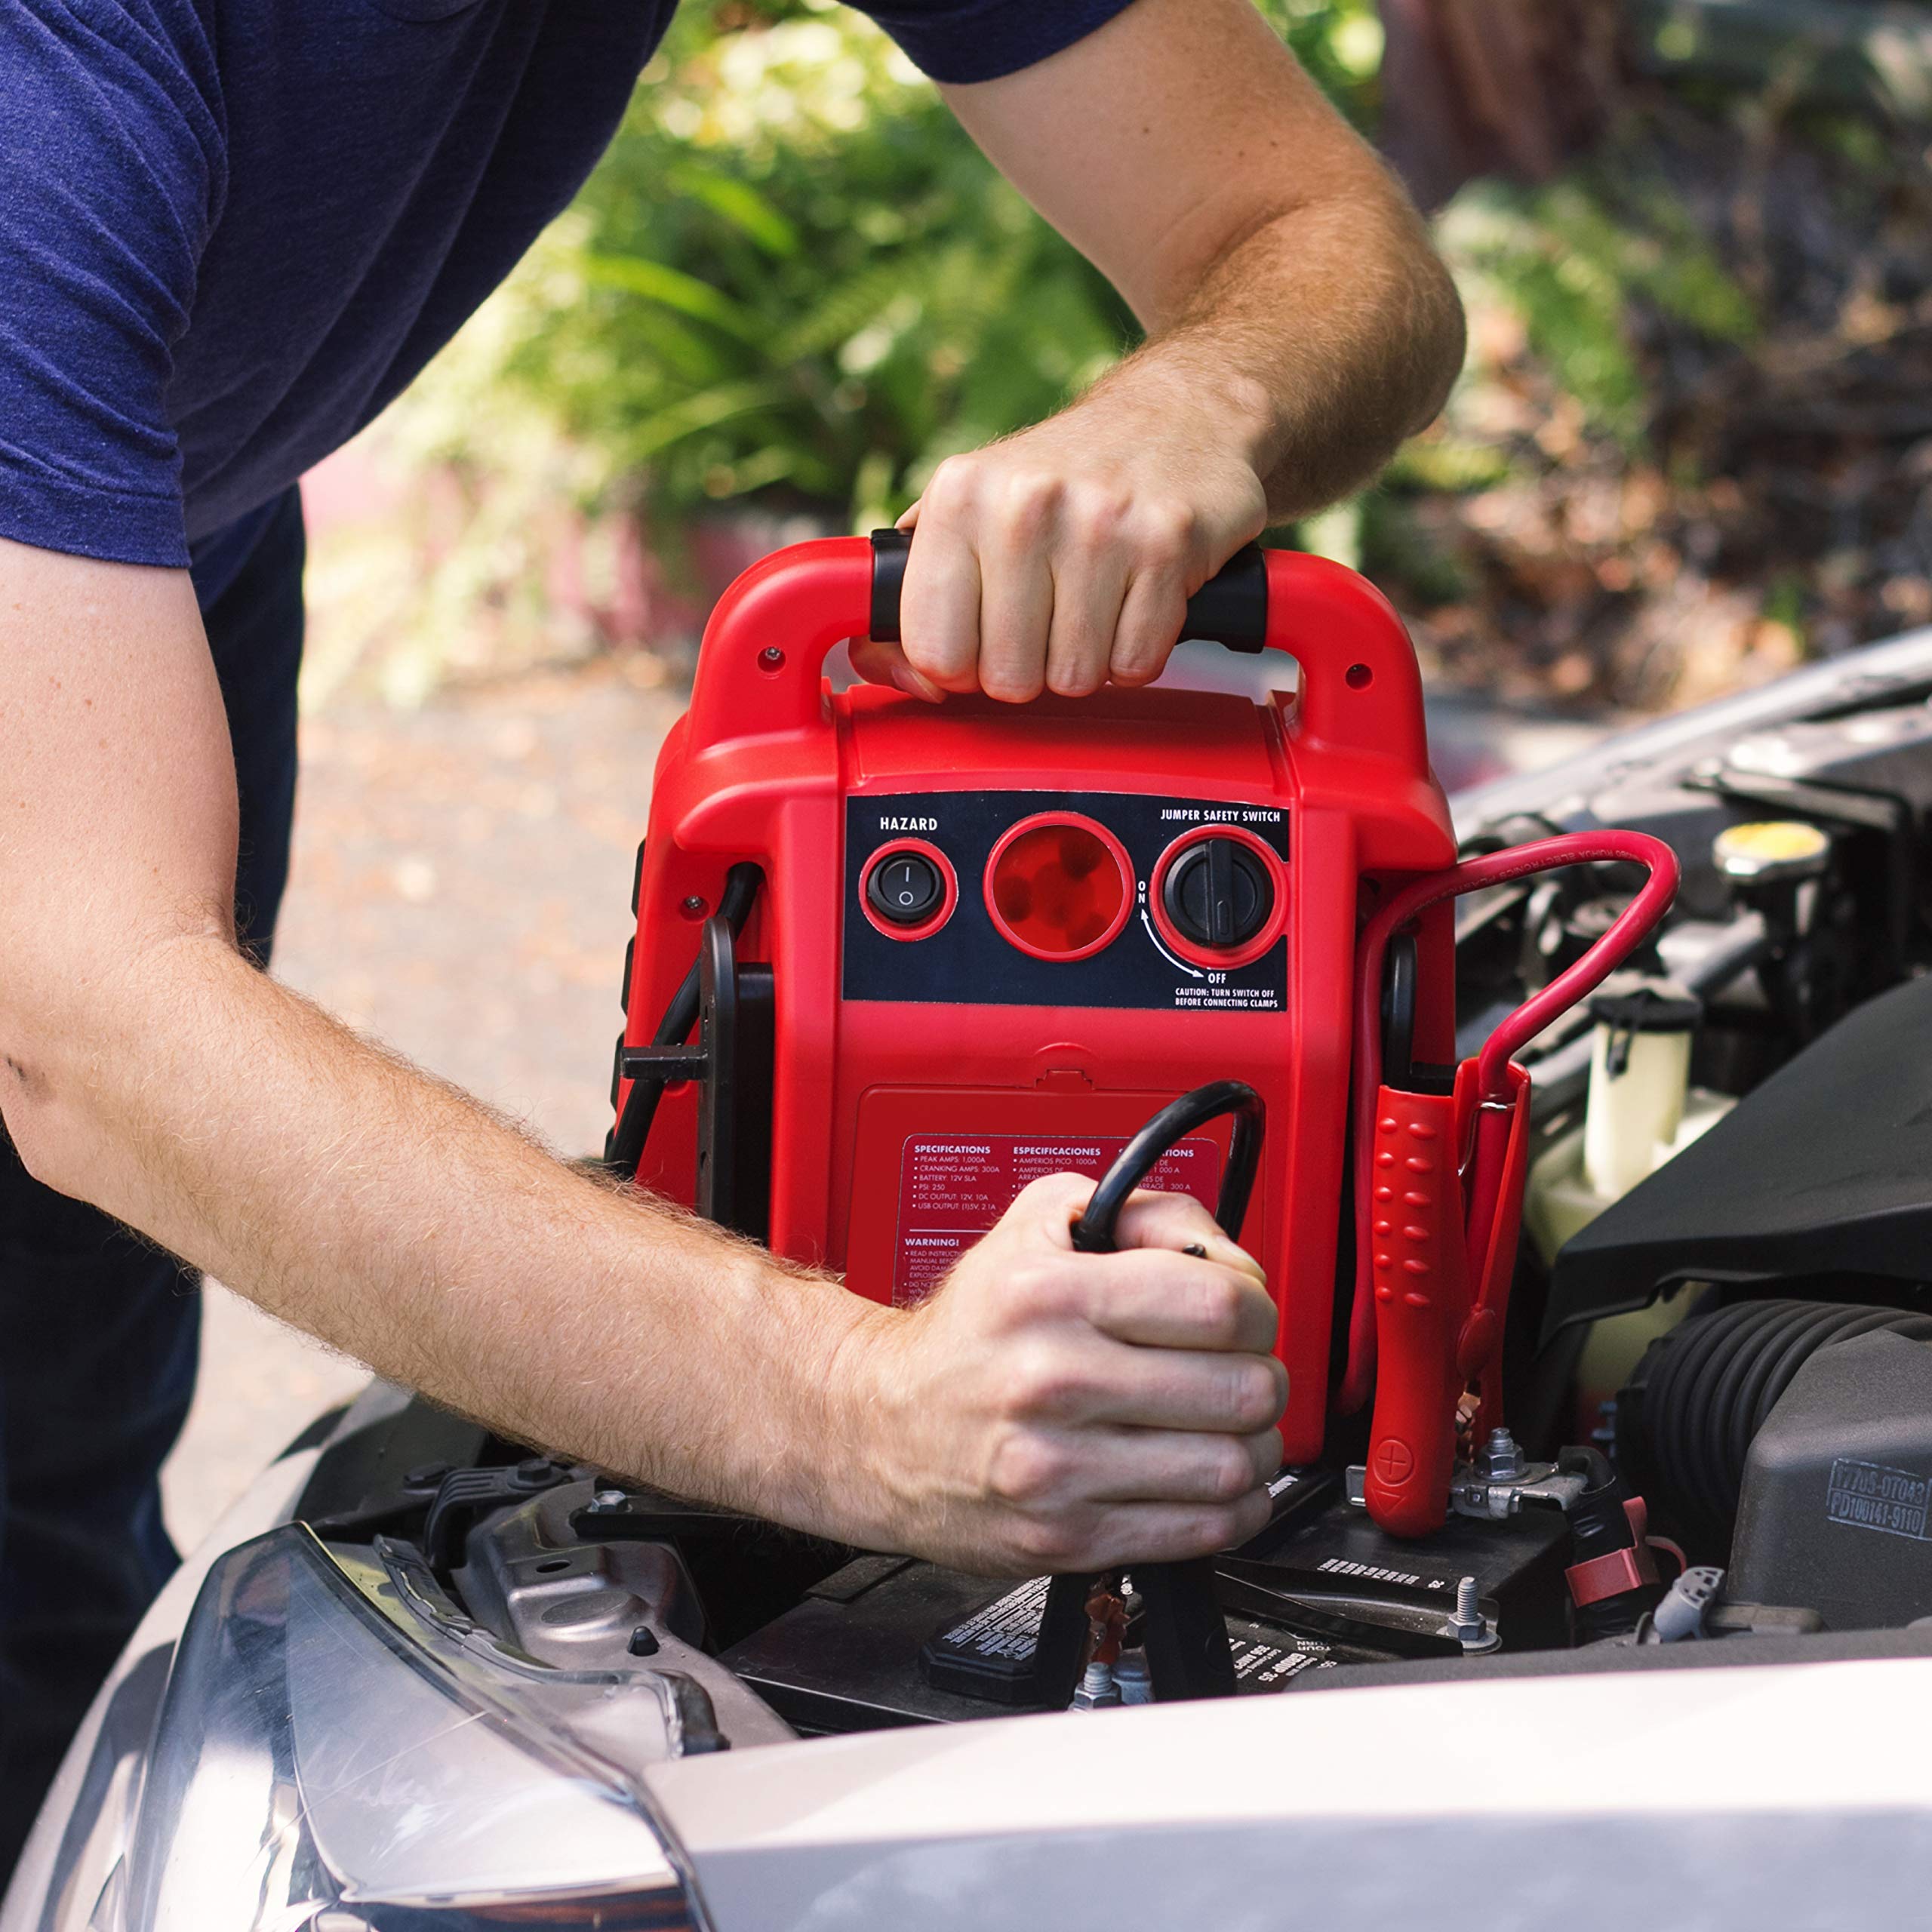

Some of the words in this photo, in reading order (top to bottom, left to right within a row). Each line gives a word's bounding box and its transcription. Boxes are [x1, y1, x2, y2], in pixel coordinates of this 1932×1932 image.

[1160, 809, 1200, 820] JUMPER
[1203, 810, 1239, 821] SAFETY
[1242, 811, 1281, 823] SWITCH
[880, 817, 937, 831] HAZARD
[1208, 973, 1226, 984] OFF
[1175, 988, 1209, 996] CAUTION:
[1211, 989, 1230, 997] TURN
[1232, 989, 1260, 998] SWITCH
[1175, 998, 1201, 1006] BEFORE
[1203, 998, 1248, 1007] CONNECTING
[1250, 999, 1278, 1008] CLAMPS
[915, 1145, 991, 1154] SPECIFICATIONS
[1014, 1146, 1101, 1156] ESPECIFICACIONES
[905, 1238, 959, 1247] WARNING!
